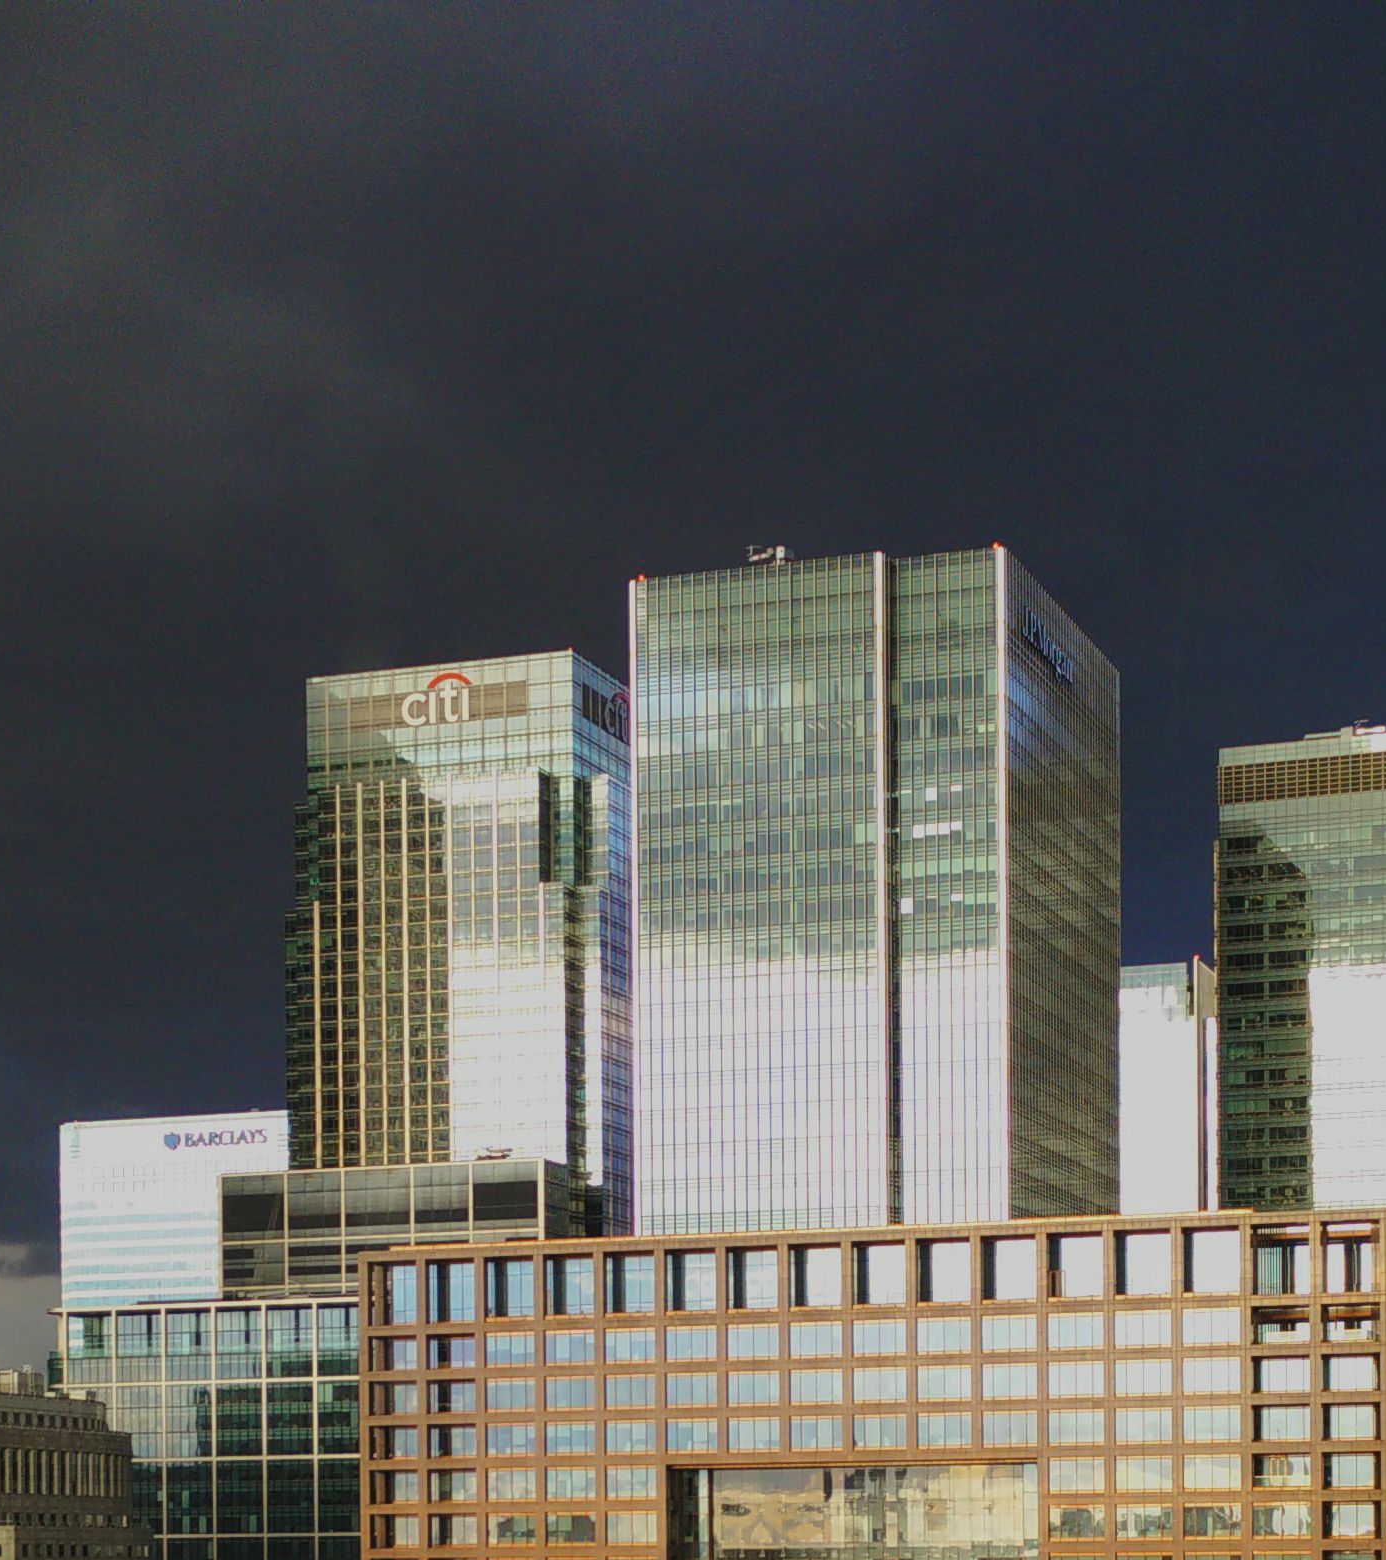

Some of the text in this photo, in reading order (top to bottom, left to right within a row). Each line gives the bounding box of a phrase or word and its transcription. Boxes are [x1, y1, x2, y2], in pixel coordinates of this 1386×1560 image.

[401, 679, 471, 727] citi
[604, 700, 629, 744] cit
[184, 1128, 268, 1148] BARCLAYS
